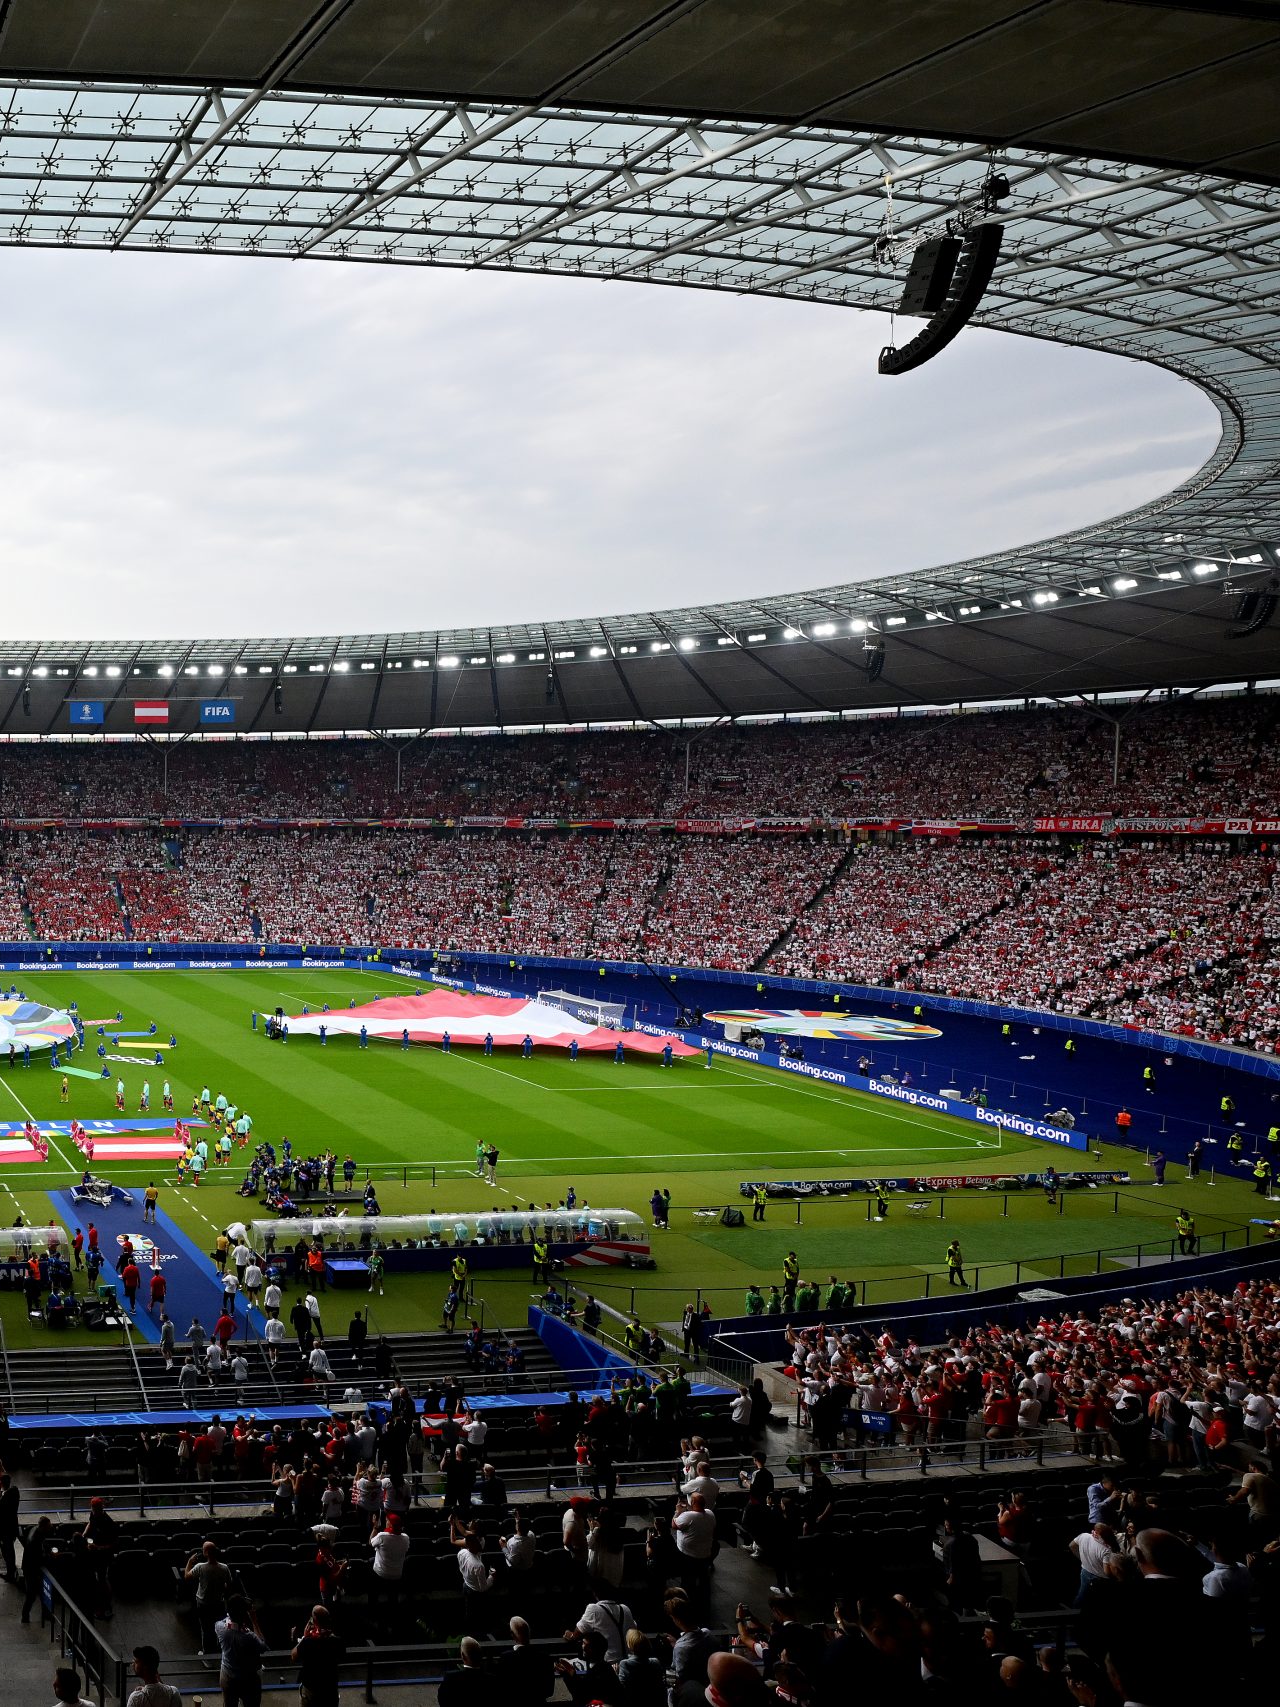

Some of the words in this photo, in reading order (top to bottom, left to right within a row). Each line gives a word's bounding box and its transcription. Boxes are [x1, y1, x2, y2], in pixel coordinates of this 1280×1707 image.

[204, 706, 230, 716] FIFA
[1035, 819, 1055, 830] SIA
[1072, 819, 1100, 830] RKA
[1228, 822, 1248, 830] PA
[19, 963, 62, 971] Booking.com
[77, 962, 119, 970] Booking.com
[190, 961, 231, 969] Booking.com
[245, 960, 288, 968] Booking.com
[302, 960, 344, 968] Booking.com
[392, 966, 421, 978] Booking.com
[432, 974, 464, 988] Booking.com
[476, 984, 511, 998] Booking.com
[577, 1008, 620, 1025] Booking.com
[701, 1038, 759, 1061] Boking.com
[779, 1056, 846, 1083] Booking.com
[869, 1080, 948, 1110] Booking.com
[976, 1106, 1070, 1144] Booking.com
